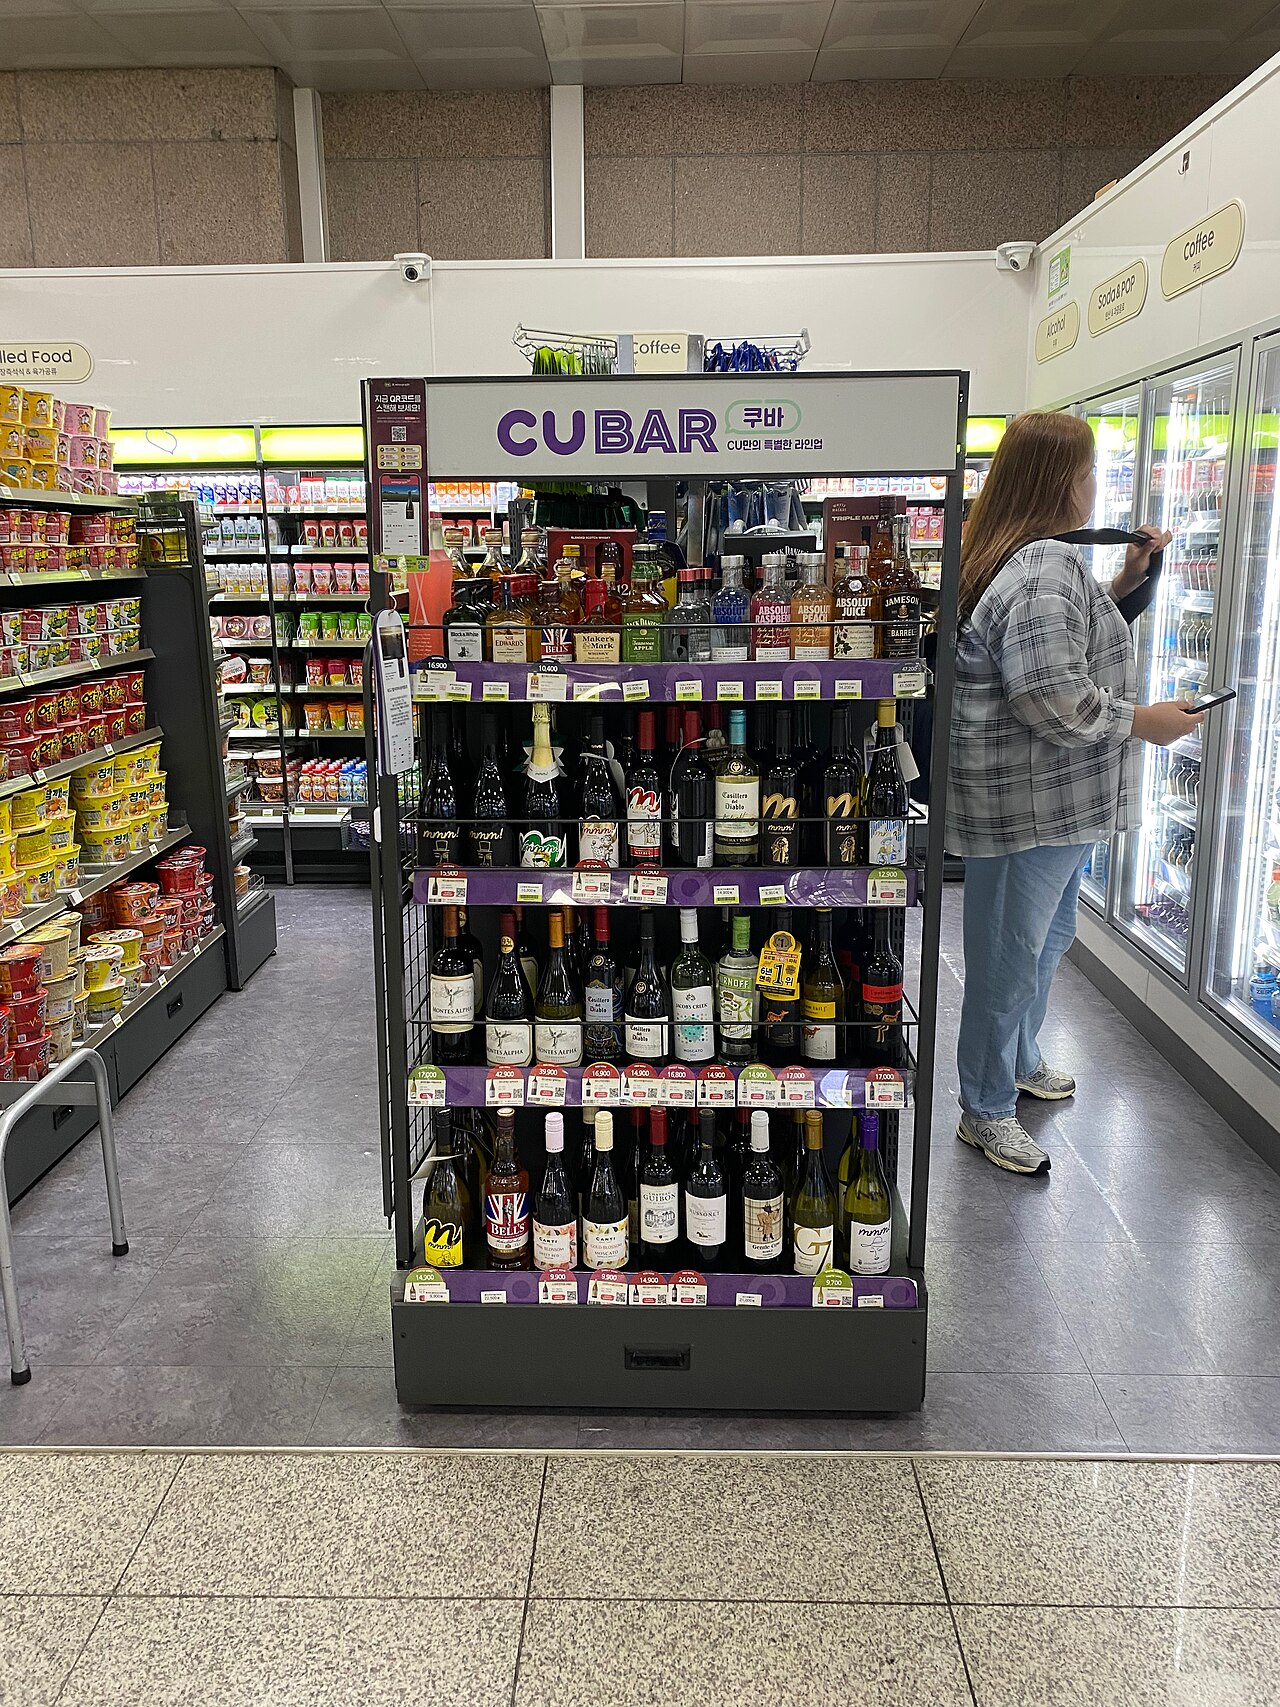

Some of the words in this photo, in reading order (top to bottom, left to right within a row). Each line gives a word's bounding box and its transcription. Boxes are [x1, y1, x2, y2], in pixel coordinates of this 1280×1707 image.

[1184, 230, 1215, 261] Coffee
[1046, 314, 1066, 338] Alcohol
[32, 349, 72, 363] Food
[374, 394, 389, 403] 지금
[390, 394, 421, 403] QR코드를
[743, 406, 785, 428] 쿠바
[496, 409, 586, 456] CU
[594, 408, 719, 454] BAR
[727, 438, 761, 450] CU만의
[764, 438, 793, 450] 특별한
[794, 438, 823, 450] 라인업
[616, 584, 629, 596] 12
[836, 597, 873, 607] ABSOLUT
[885, 596, 919, 607] JAMESON
[713, 606, 746, 616] ABSOLUT
[798, 605, 831, 614] ABSOLUT
[841, 607, 866, 617] JUICE
[802, 614, 828, 623] PEACH
[891, 629, 914, 637] BARREL
[545, 644, 568, 653] BELL'S
[428, 661, 447, 669] 16,900
[538, 665, 558, 673] 10,400
[423, 826, 460, 840] mmm!
[469, 827, 504, 840] mmm!
[761, 967, 773, 976] 6년
[590, 1005, 607, 1013] Diablo
[632, 1034, 648, 1042] Diablo
[503, 1048, 523, 1056] ALPHA
[558, 1047, 577, 1056] ALPHA
[495, 1070, 515, 1078] 42,900
[539, 1068, 558, 1076] 39,900
[748, 1071, 767, 1079] 14,900
[981, 1127, 996, 1143] N
[643, 1193, 676, 1202] GUIBON
[490, 1222, 525, 1236] BELL'S
[678, 1276, 698, 1284] 24,000
